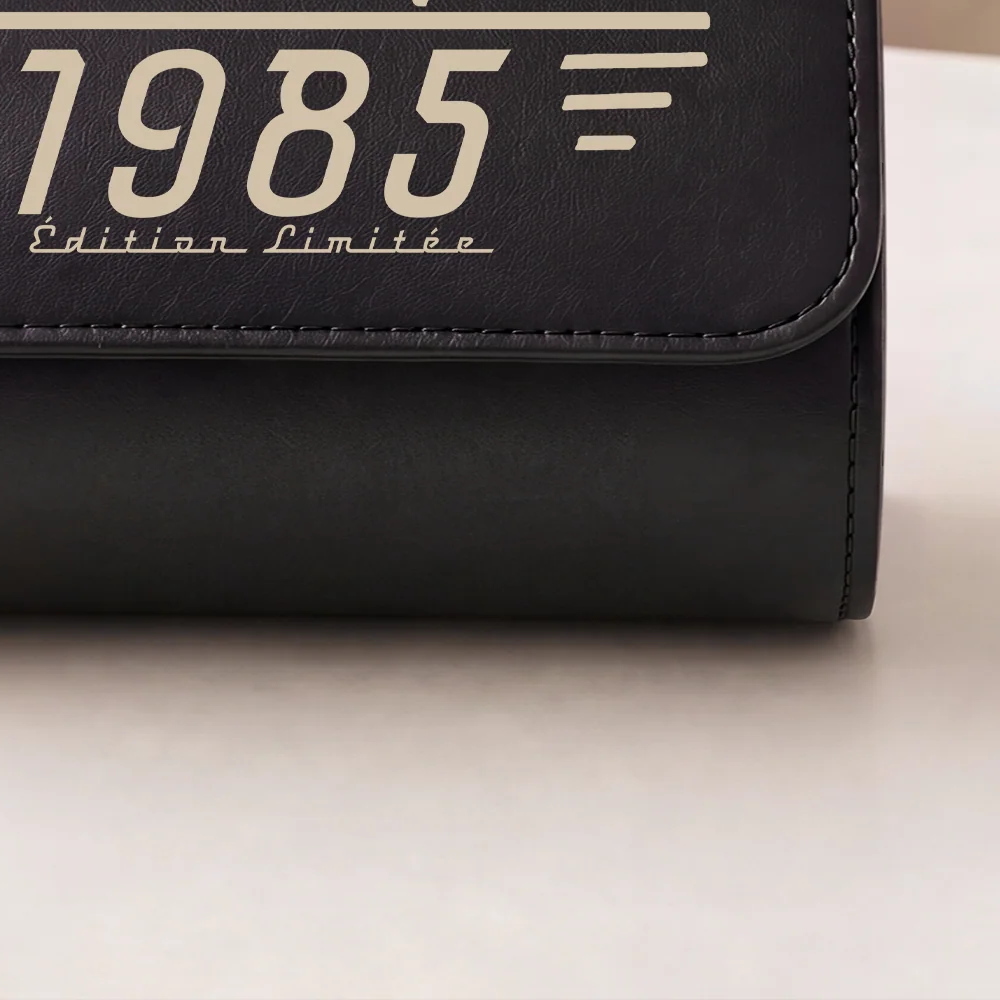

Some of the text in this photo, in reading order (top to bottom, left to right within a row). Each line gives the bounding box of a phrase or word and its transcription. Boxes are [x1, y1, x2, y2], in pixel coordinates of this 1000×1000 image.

[17, 48, 512, 219] 1985
[28, 215, 495, 254] Édition Limitée
